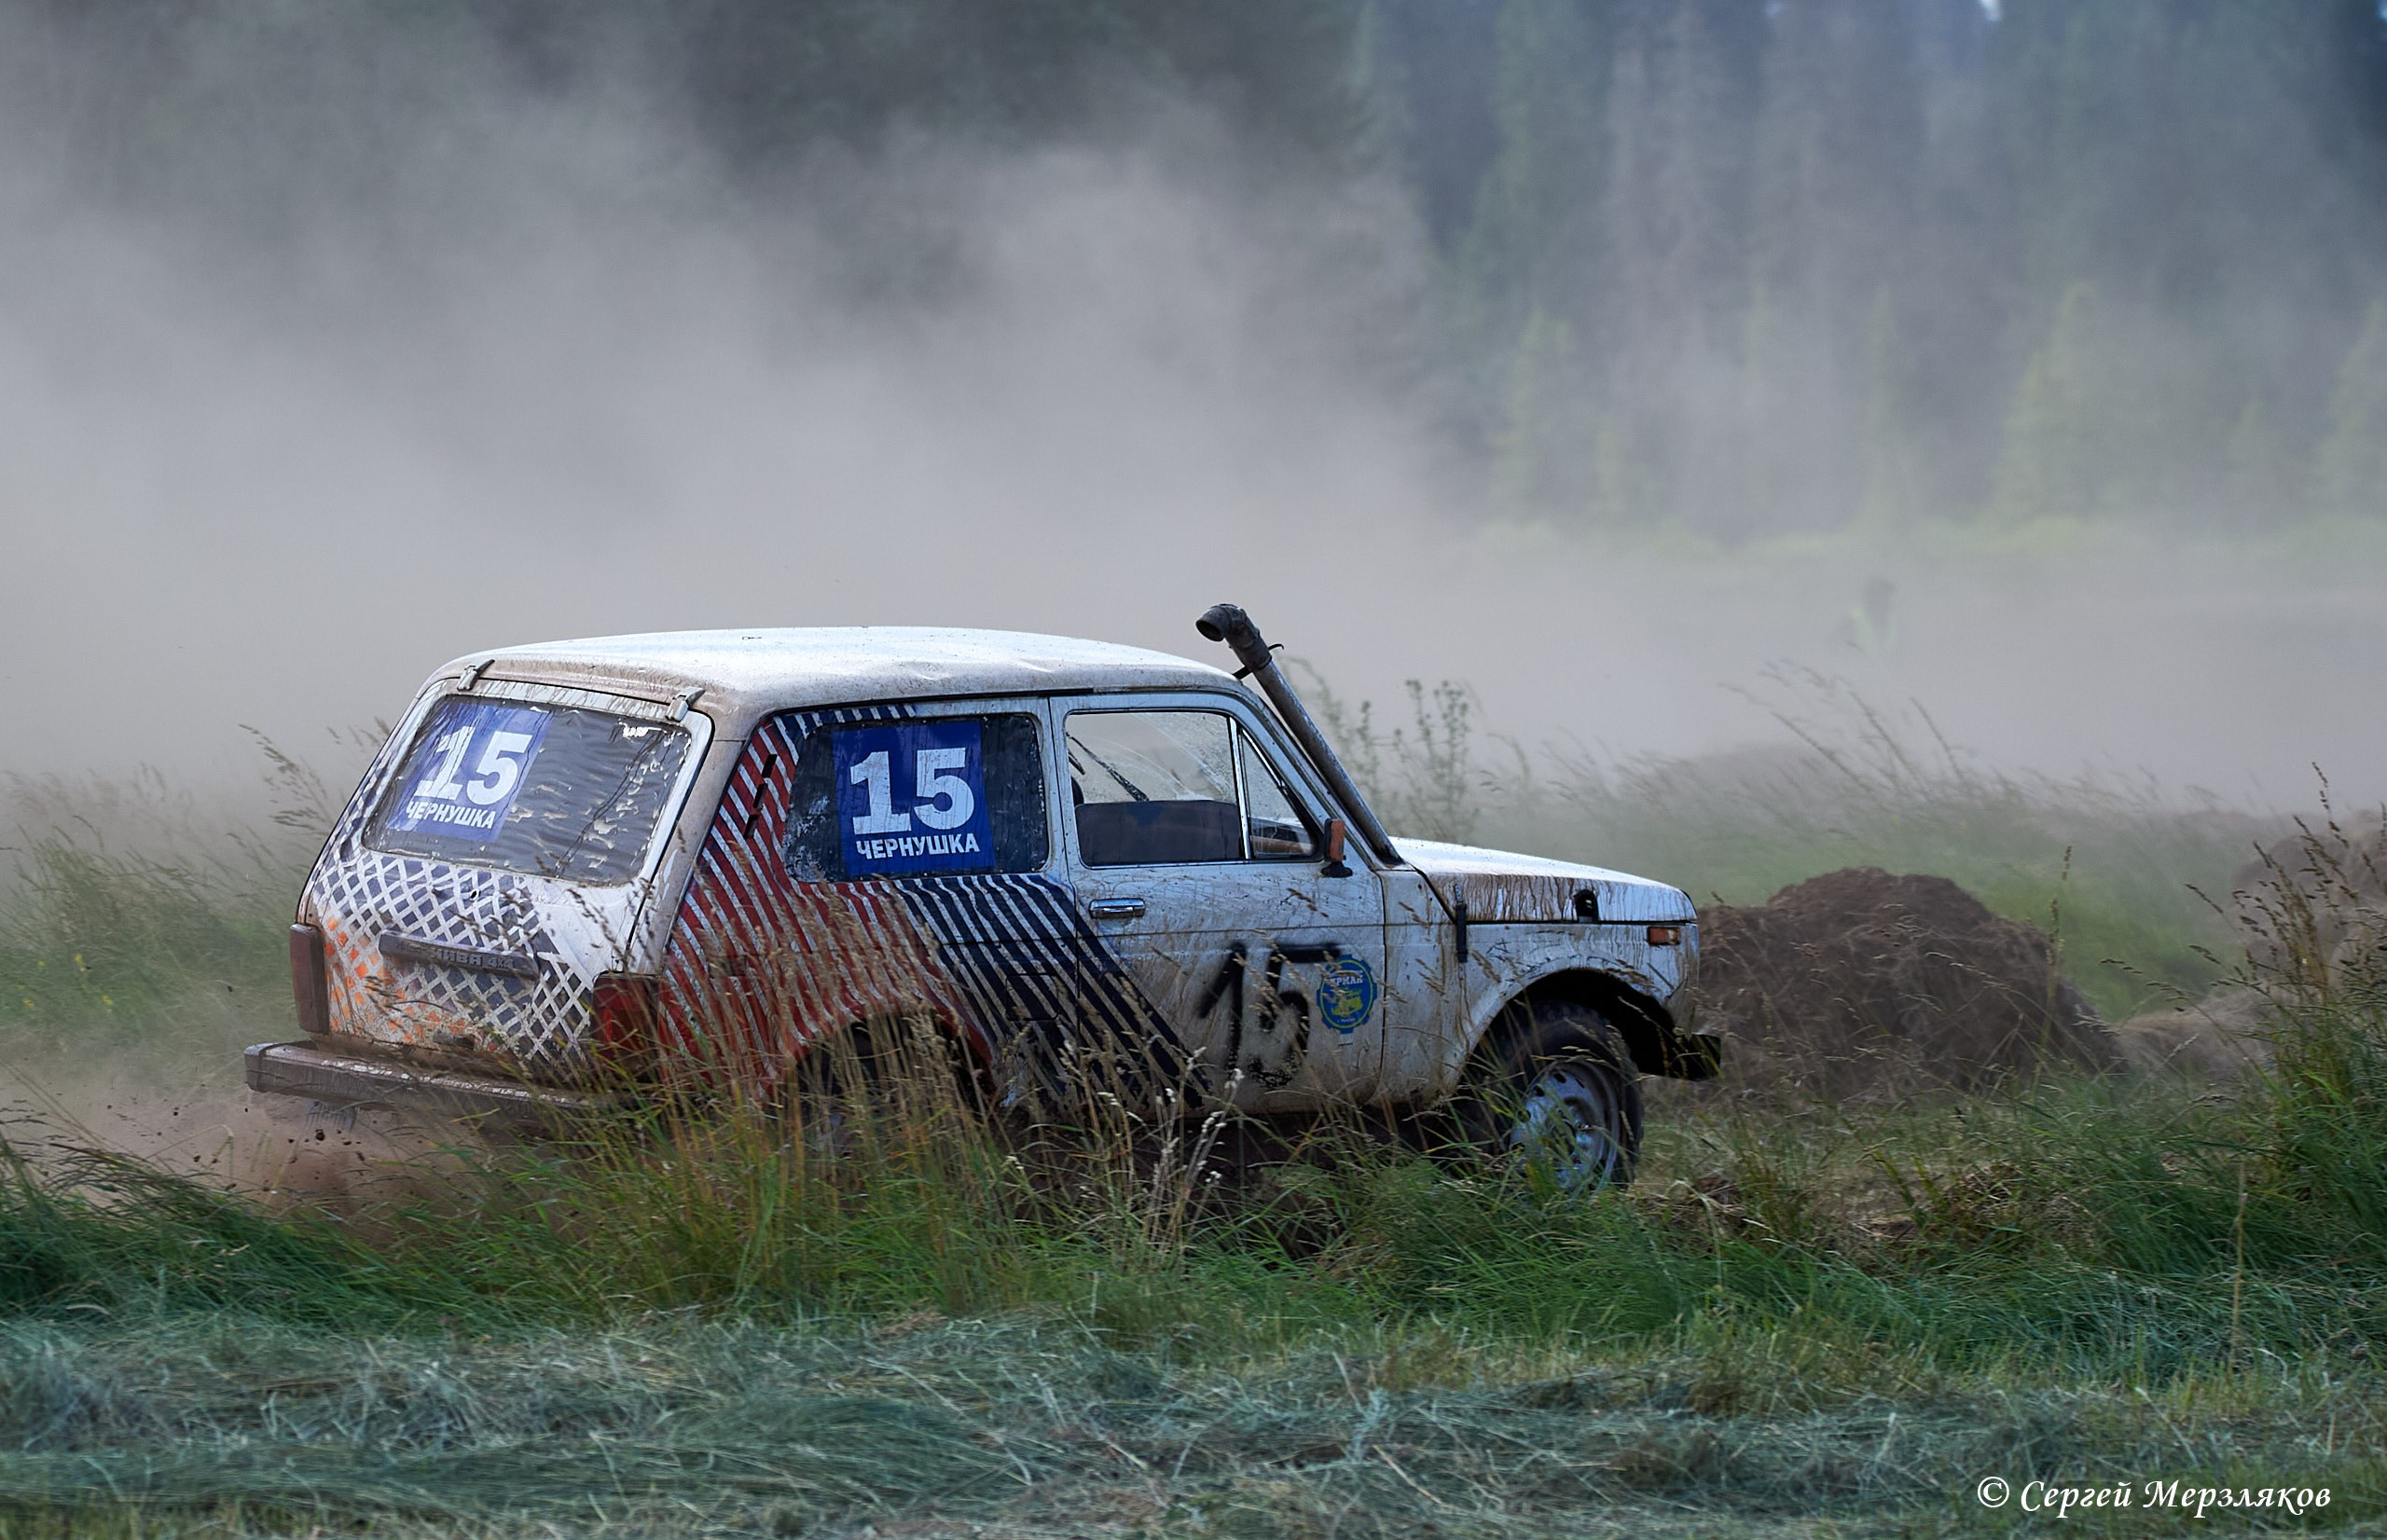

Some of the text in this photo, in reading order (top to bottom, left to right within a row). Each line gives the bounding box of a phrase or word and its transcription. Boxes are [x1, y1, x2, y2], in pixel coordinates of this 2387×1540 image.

[413, 726, 533, 805] 15
[849, 747, 975, 835] 15
[405, 801, 496, 829] ЧЕРНУШКА
[855, 832, 980, 859] ЧЕРНУШКА
[1329, 974, 1363, 985] РМАК
[1197, 941, 1341, 1088] 15
